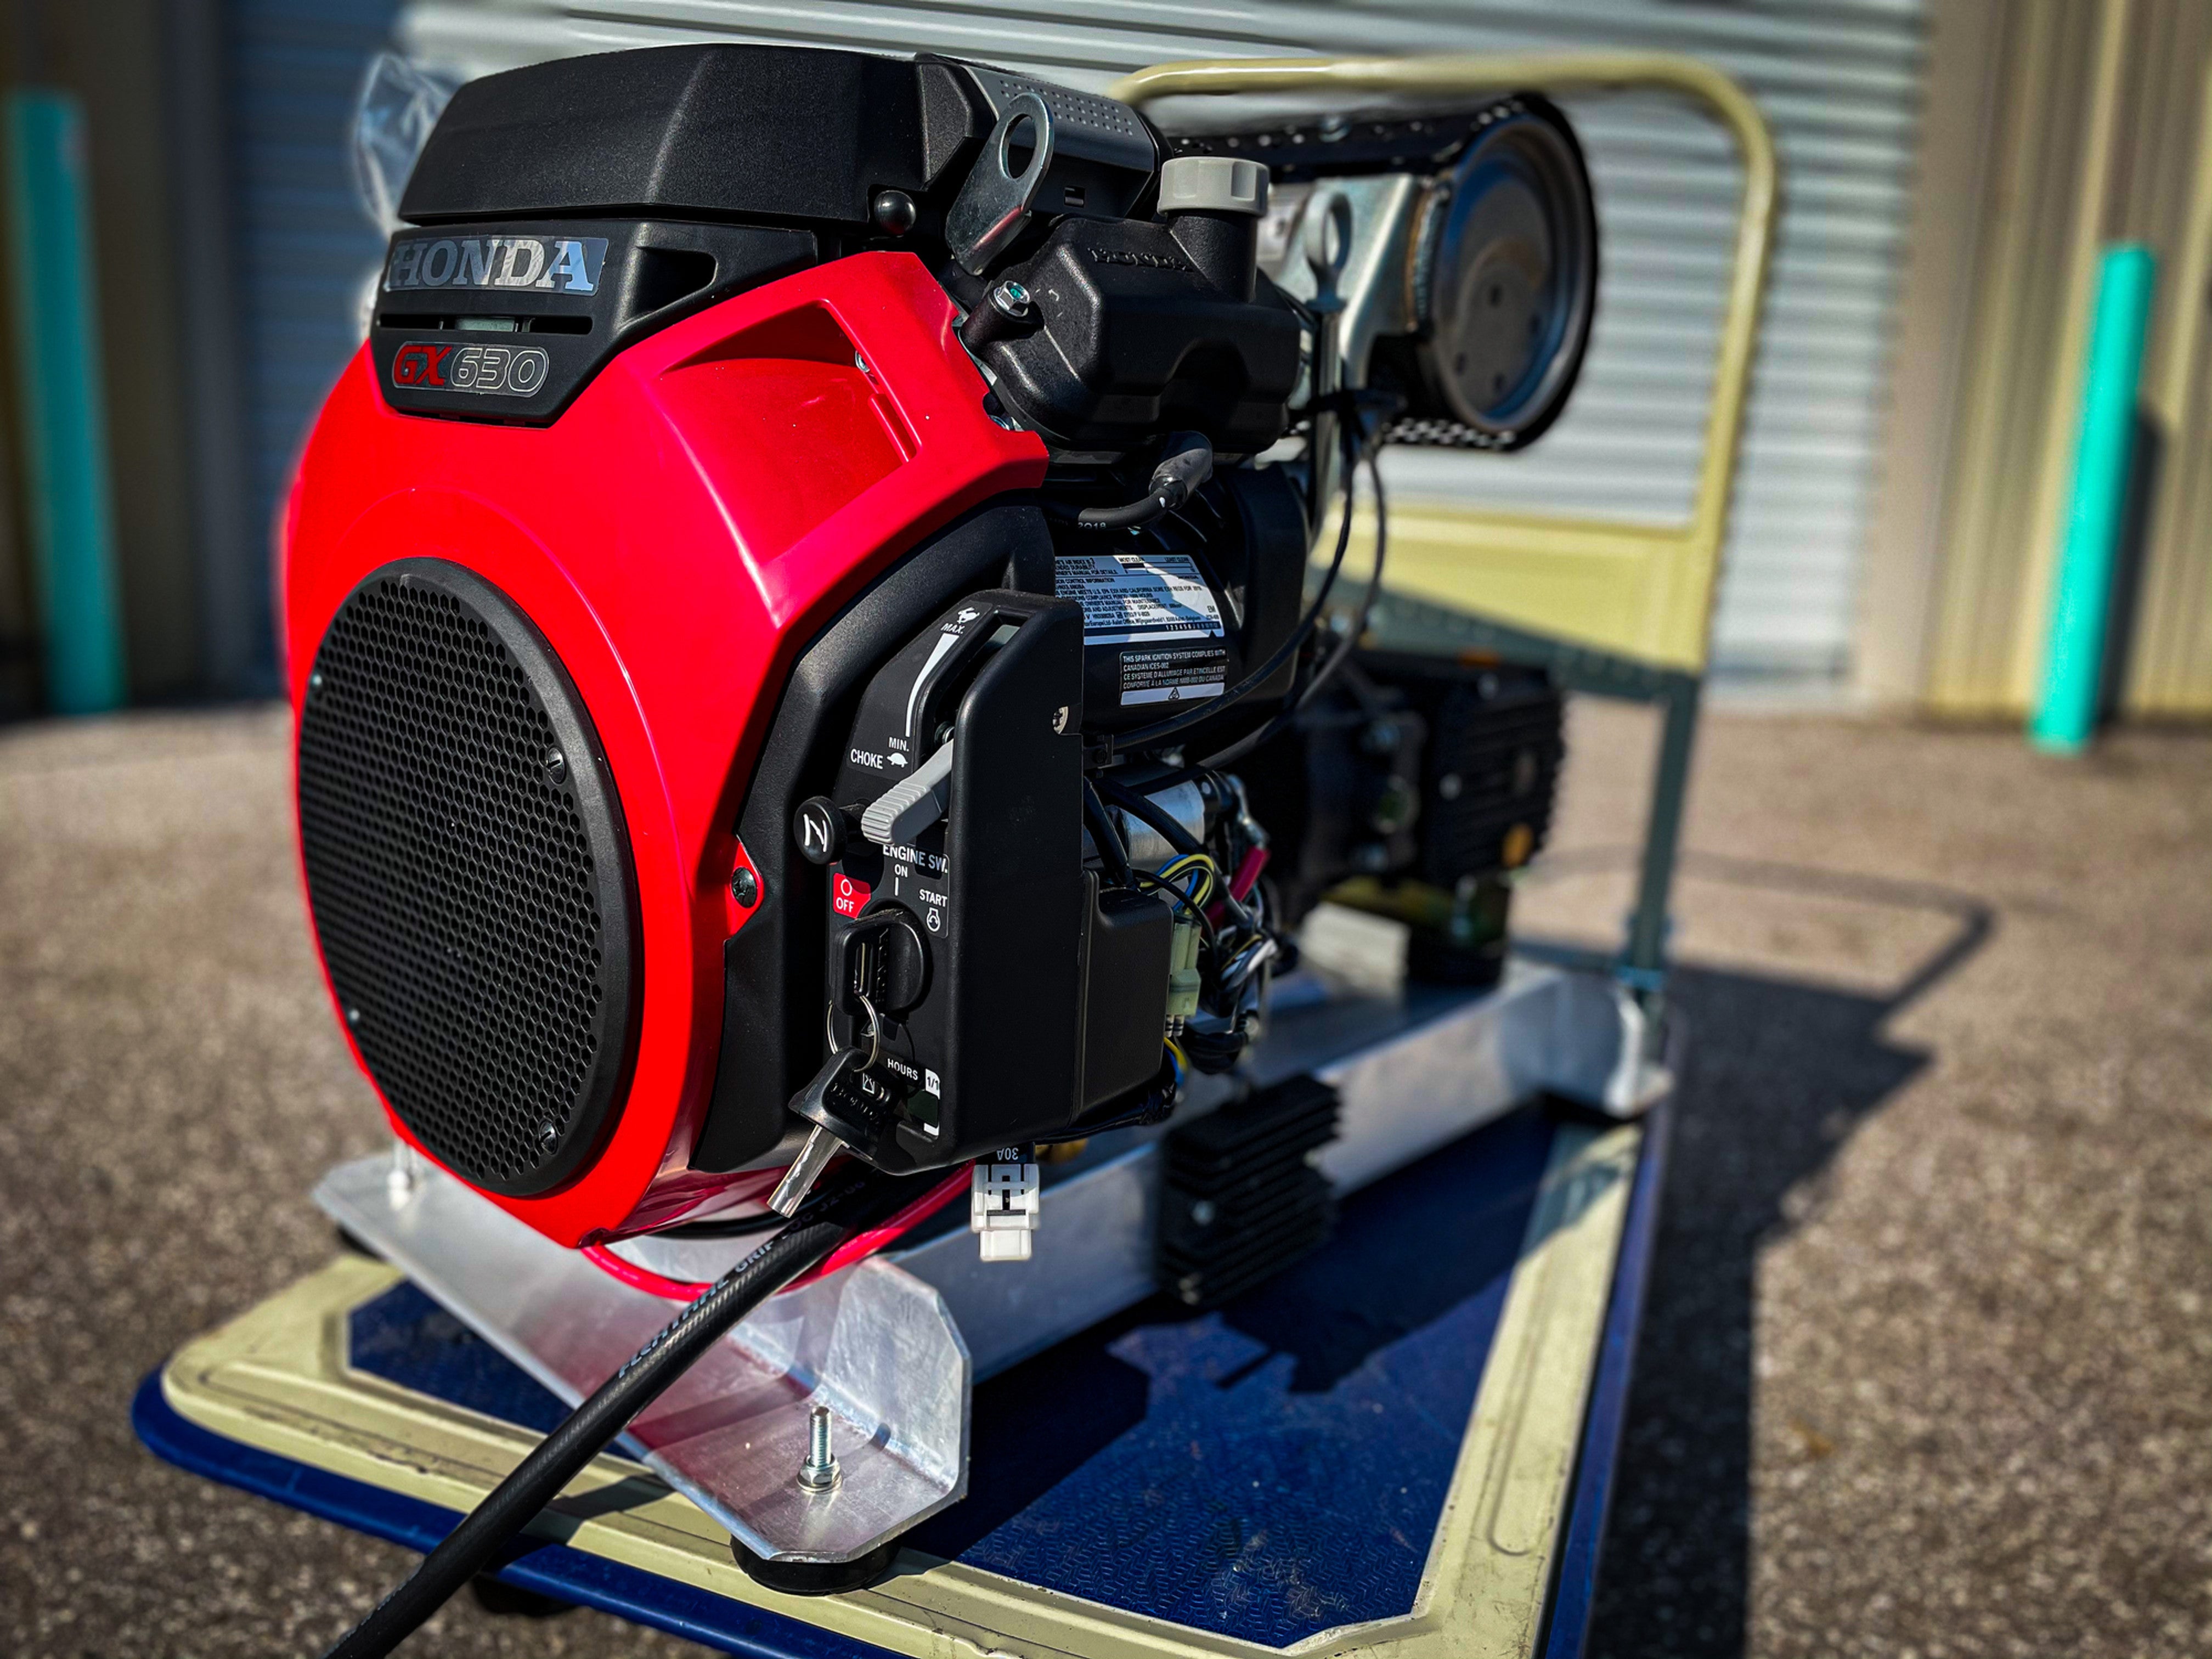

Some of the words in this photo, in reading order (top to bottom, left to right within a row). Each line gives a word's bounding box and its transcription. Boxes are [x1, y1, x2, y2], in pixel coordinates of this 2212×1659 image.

[389, 239, 594, 291] HONDA
[941, 623, 965, 634] MAX.
[1173, 651, 1191, 659] SYSTEM
[888, 736, 909, 752] MIN.
[850, 749, 883, 769] CHOKE
[883, 845, 925, 866] ENGINE
[928, 855, 948, 873] SW.
[894, 864, 908, 878] ON
[836, 897, 854, 912] OFF
[919, 889, 947, 907] START
[887, 1058, 918, 1080] HOURS
[996, 1147, 1019, 1161] 30A
